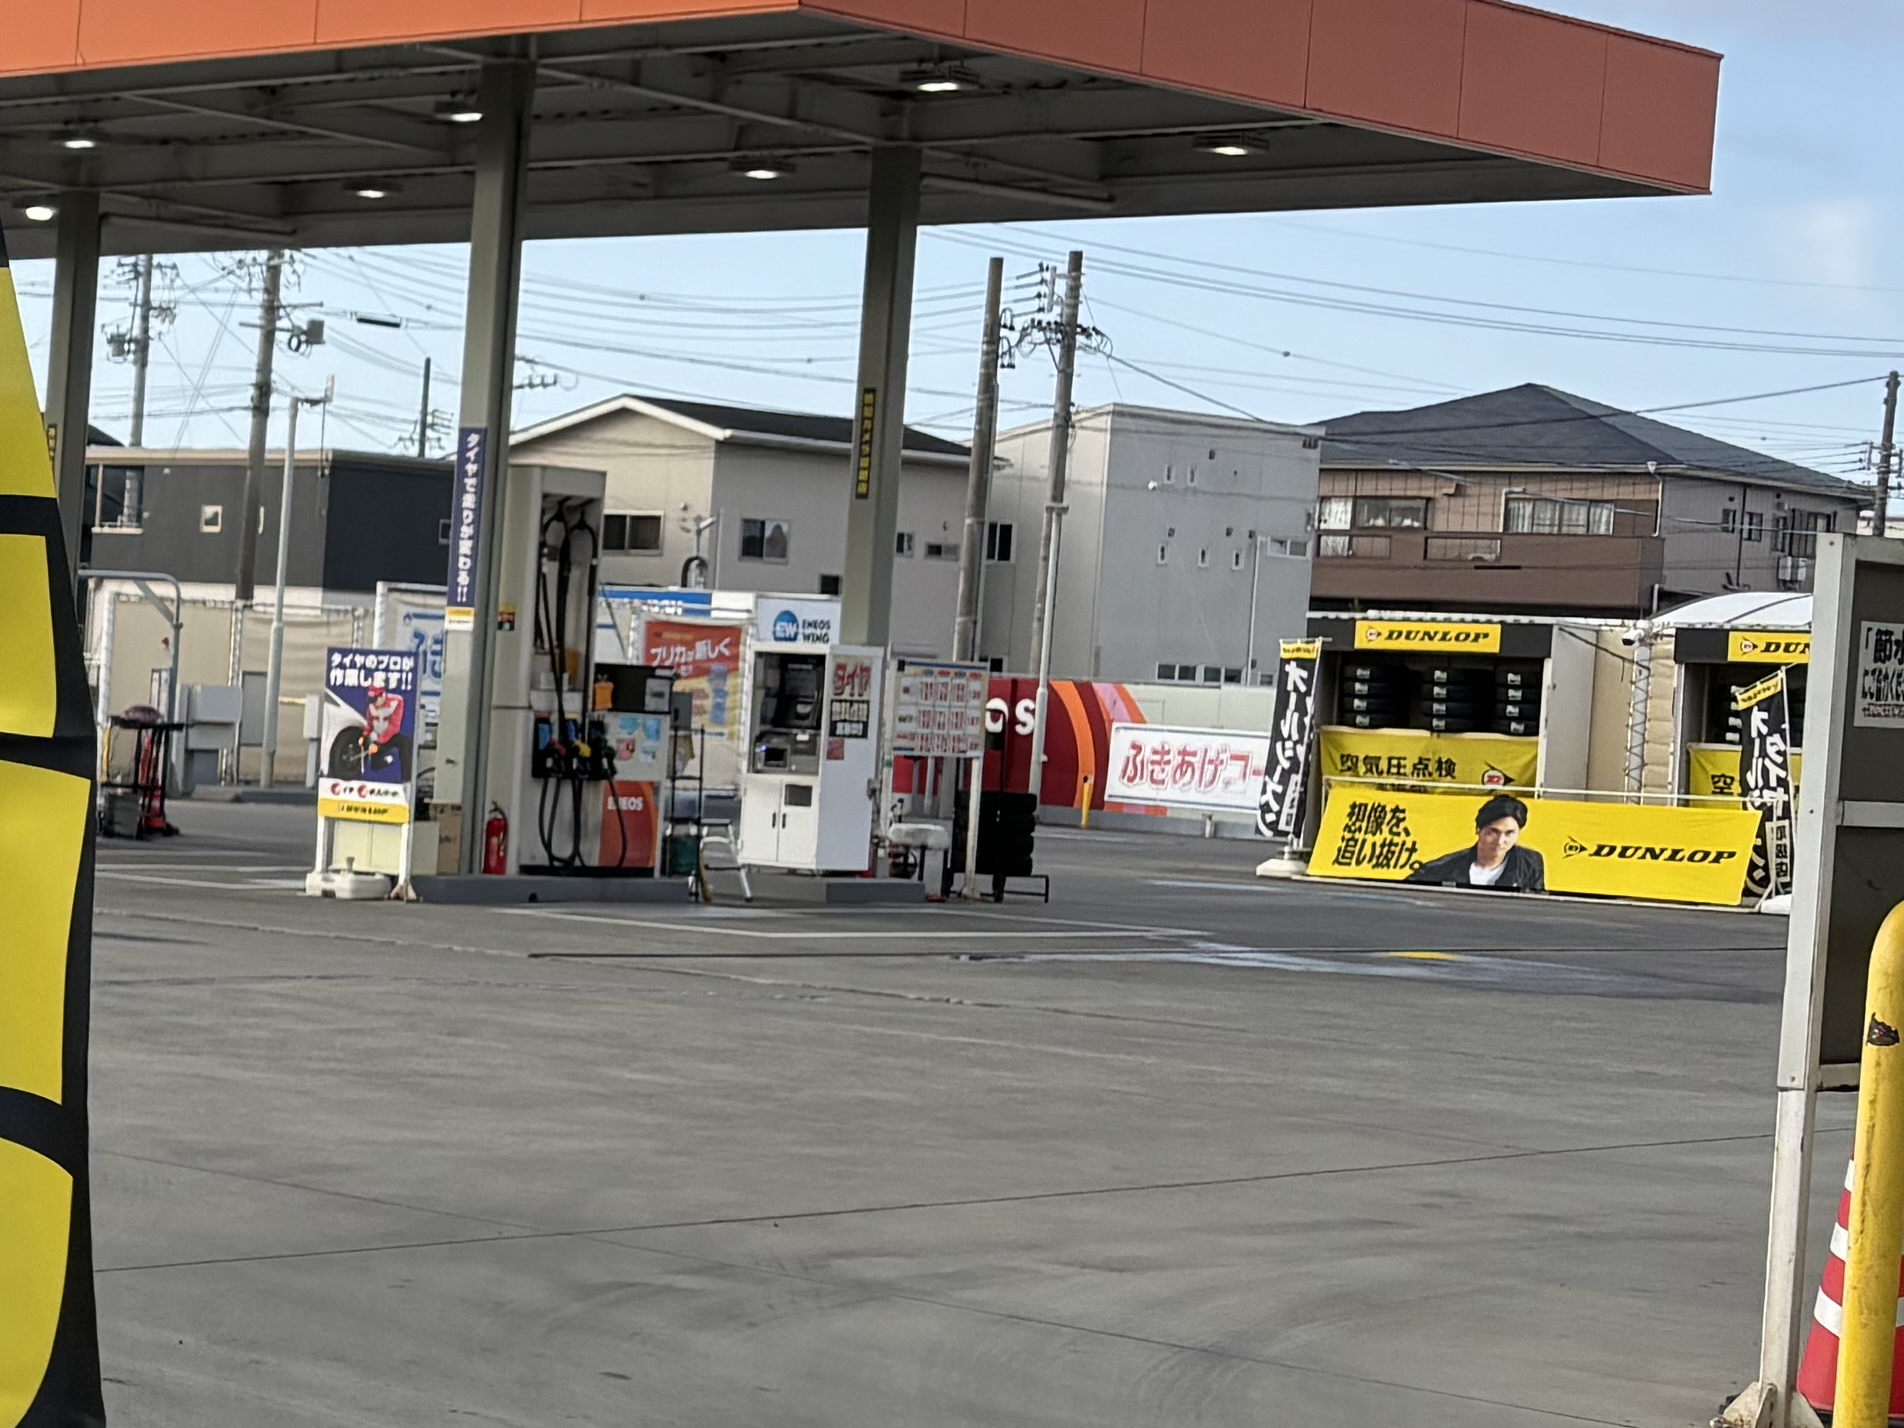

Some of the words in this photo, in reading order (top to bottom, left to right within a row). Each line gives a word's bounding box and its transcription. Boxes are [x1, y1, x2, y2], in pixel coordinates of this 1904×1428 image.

[801, 618, 831, 631] ENEOS
[801, 631, 831, 644] WING
[1384, 629, 1490, 643] DUNLOP
[330, 651, 414, 672] タイヤのプロが
[1339, 753, 1457, 780] 空気圧点検
[1343, 800, 1412, 838] 想像を、
[1332, 834, 1424, 871] 追い抜け。
[1588, 843, 1738, 865] DUNLOP
